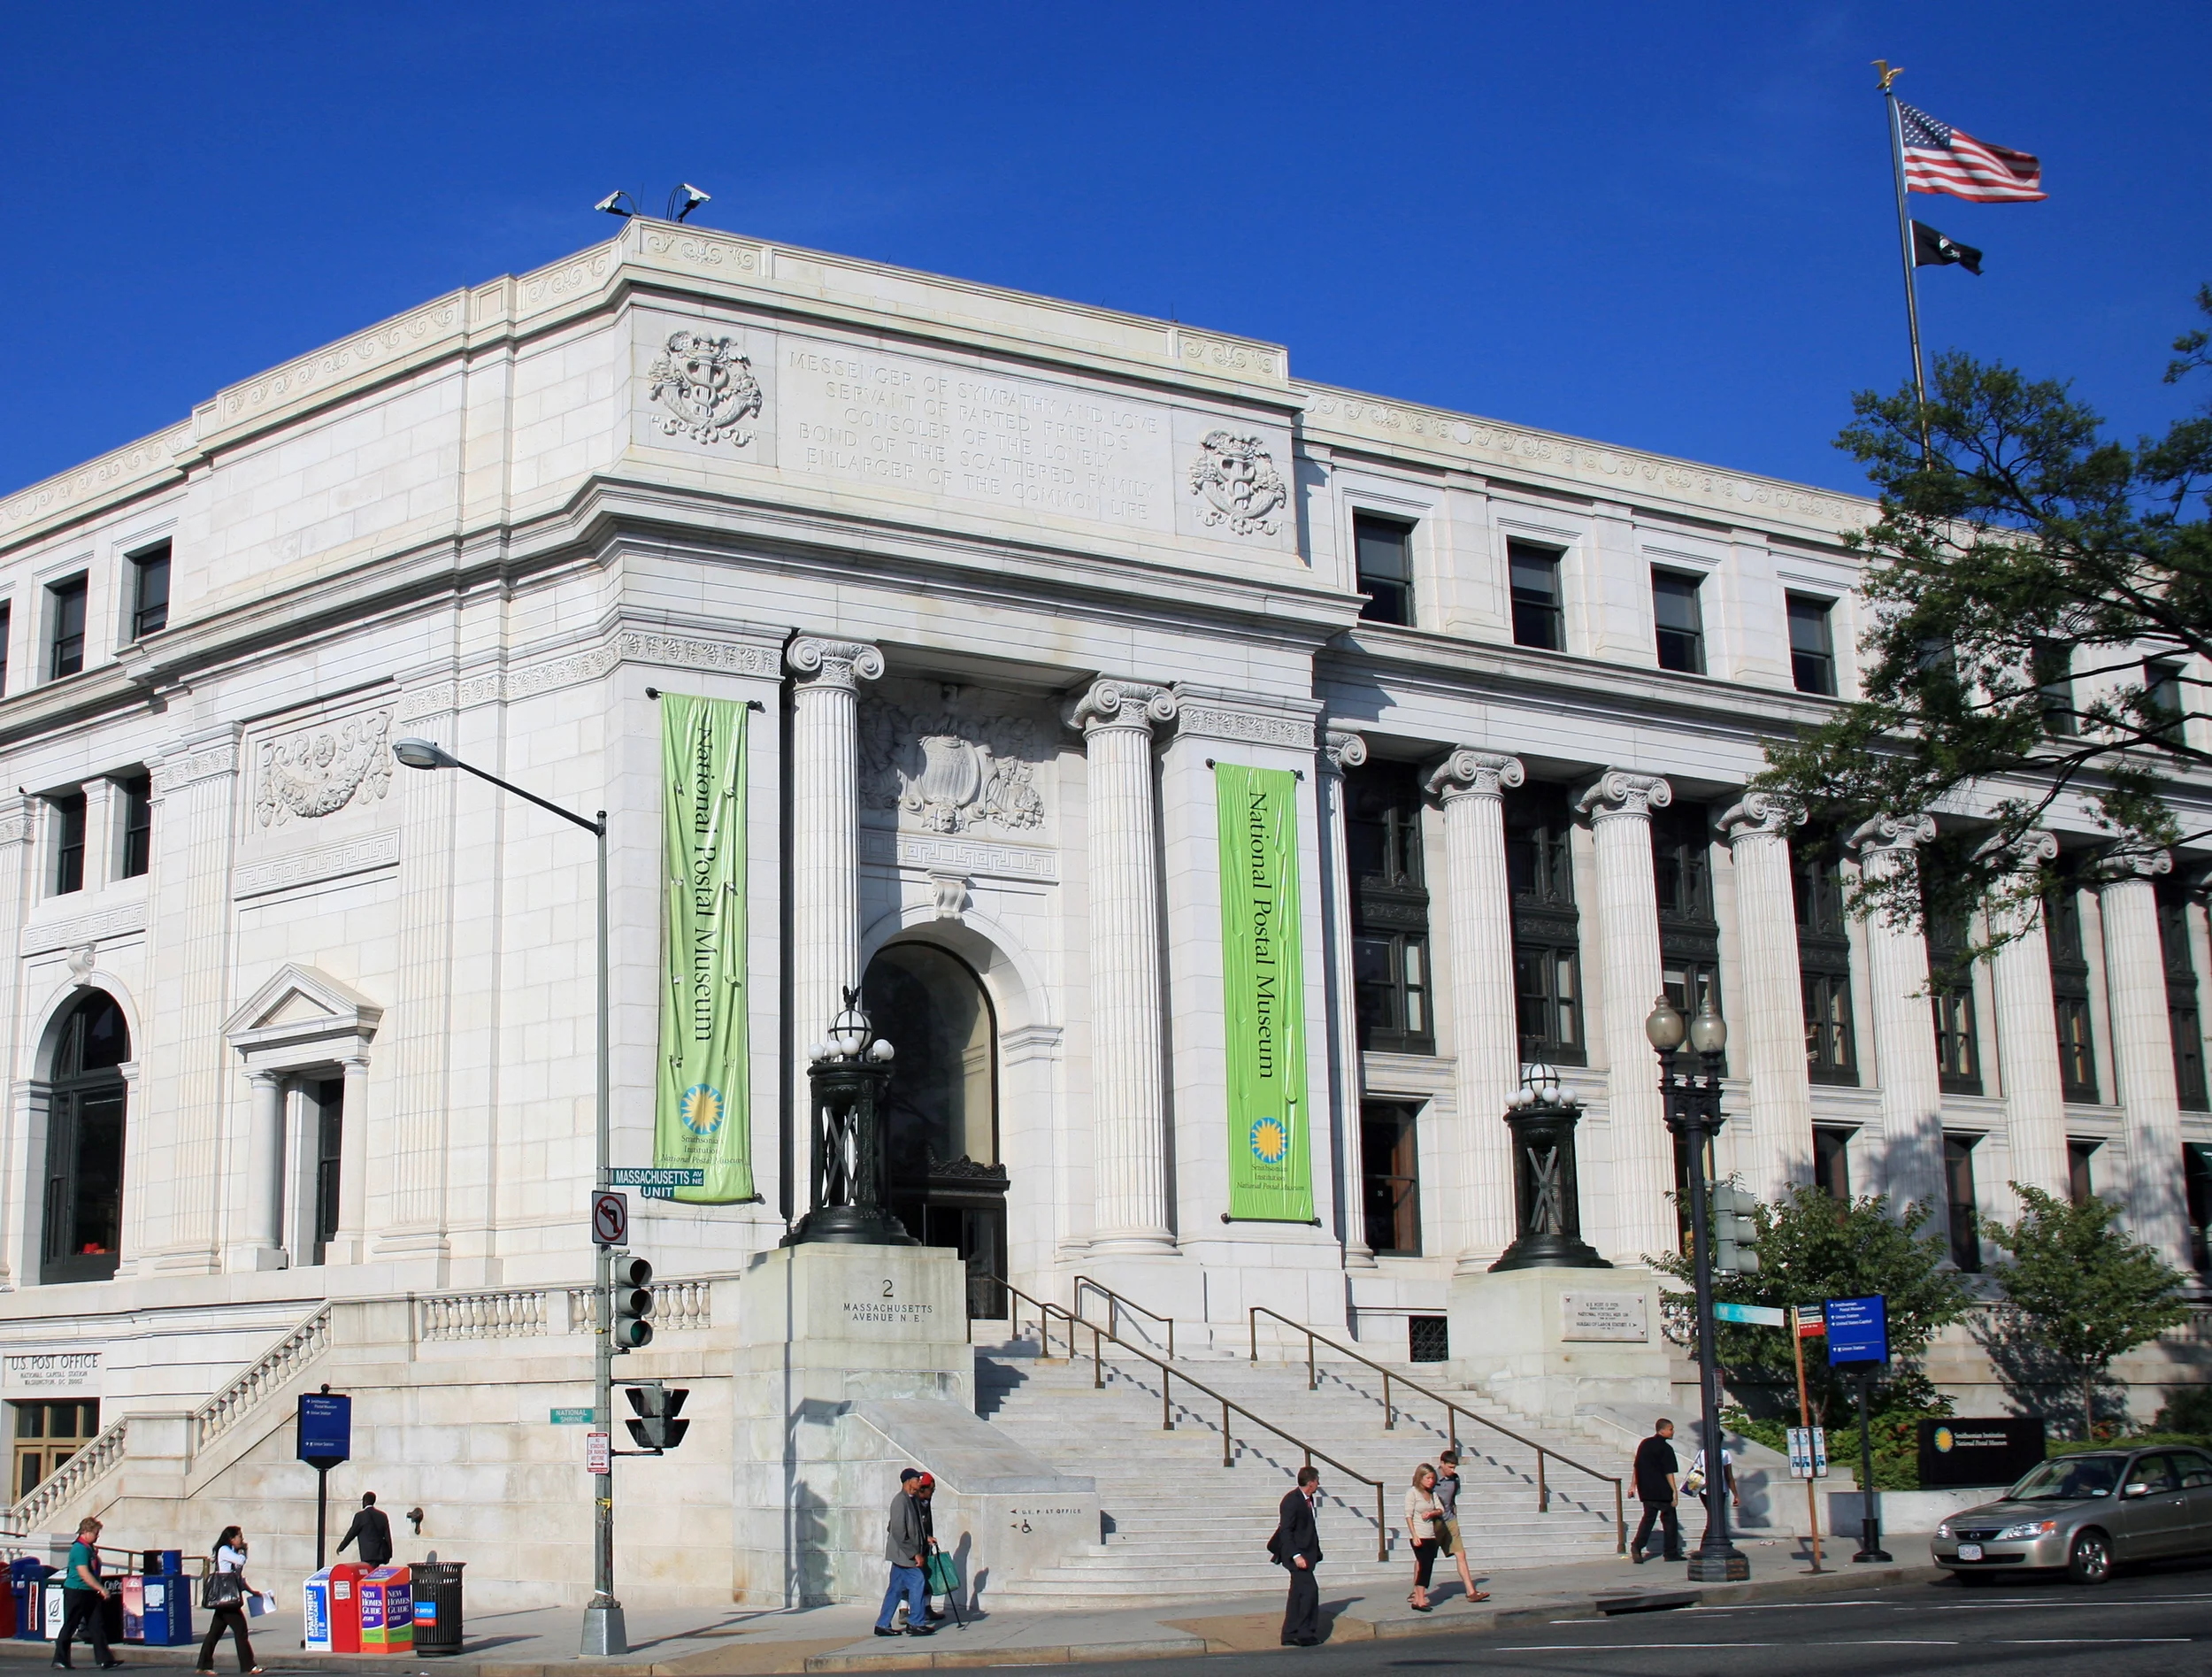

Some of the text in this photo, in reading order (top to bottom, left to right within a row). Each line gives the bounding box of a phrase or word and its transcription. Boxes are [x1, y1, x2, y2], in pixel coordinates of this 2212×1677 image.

[790, 351, 1157, 434] MESSENGER OF SYMPATHY AND LOVE
[826, 381, 1129, 450] SERVANT OF PARTED FRIENDS
[844, 407, 1113, 469] CONSOLER OF THE LONELY
[799, 422, 1154, 499] BOND OF THE SCATTERED FAMILY
[806, 447, 1148, 520] ENLARGER OF THE COMMON LIFE
[694, 727, 718, 1042] National Postal Museum
[1249, 791, 1276, 1079] National Postal Museum
[661, 1154, 690, 1163] National
[616, 1170, 689, 1185] MASSACHUSETTS
[642, 1187, 672, 1196] UNIT
[882, 1279, 894, 1297] 2
[843, 1303, 933, 1313] MASSACHUSETTS
[852, 1312, 894, 1322] AVENUE
[12, 1354, 99, 1370] U.S. POST OFFICE
[388, 1589, 402, 1598] NEW
[388, 1596, 410, 1607] HOMES
[306, 1589, 315, 1637] APARTMENT
[388, 1604, 409, 1614] GUIDE
